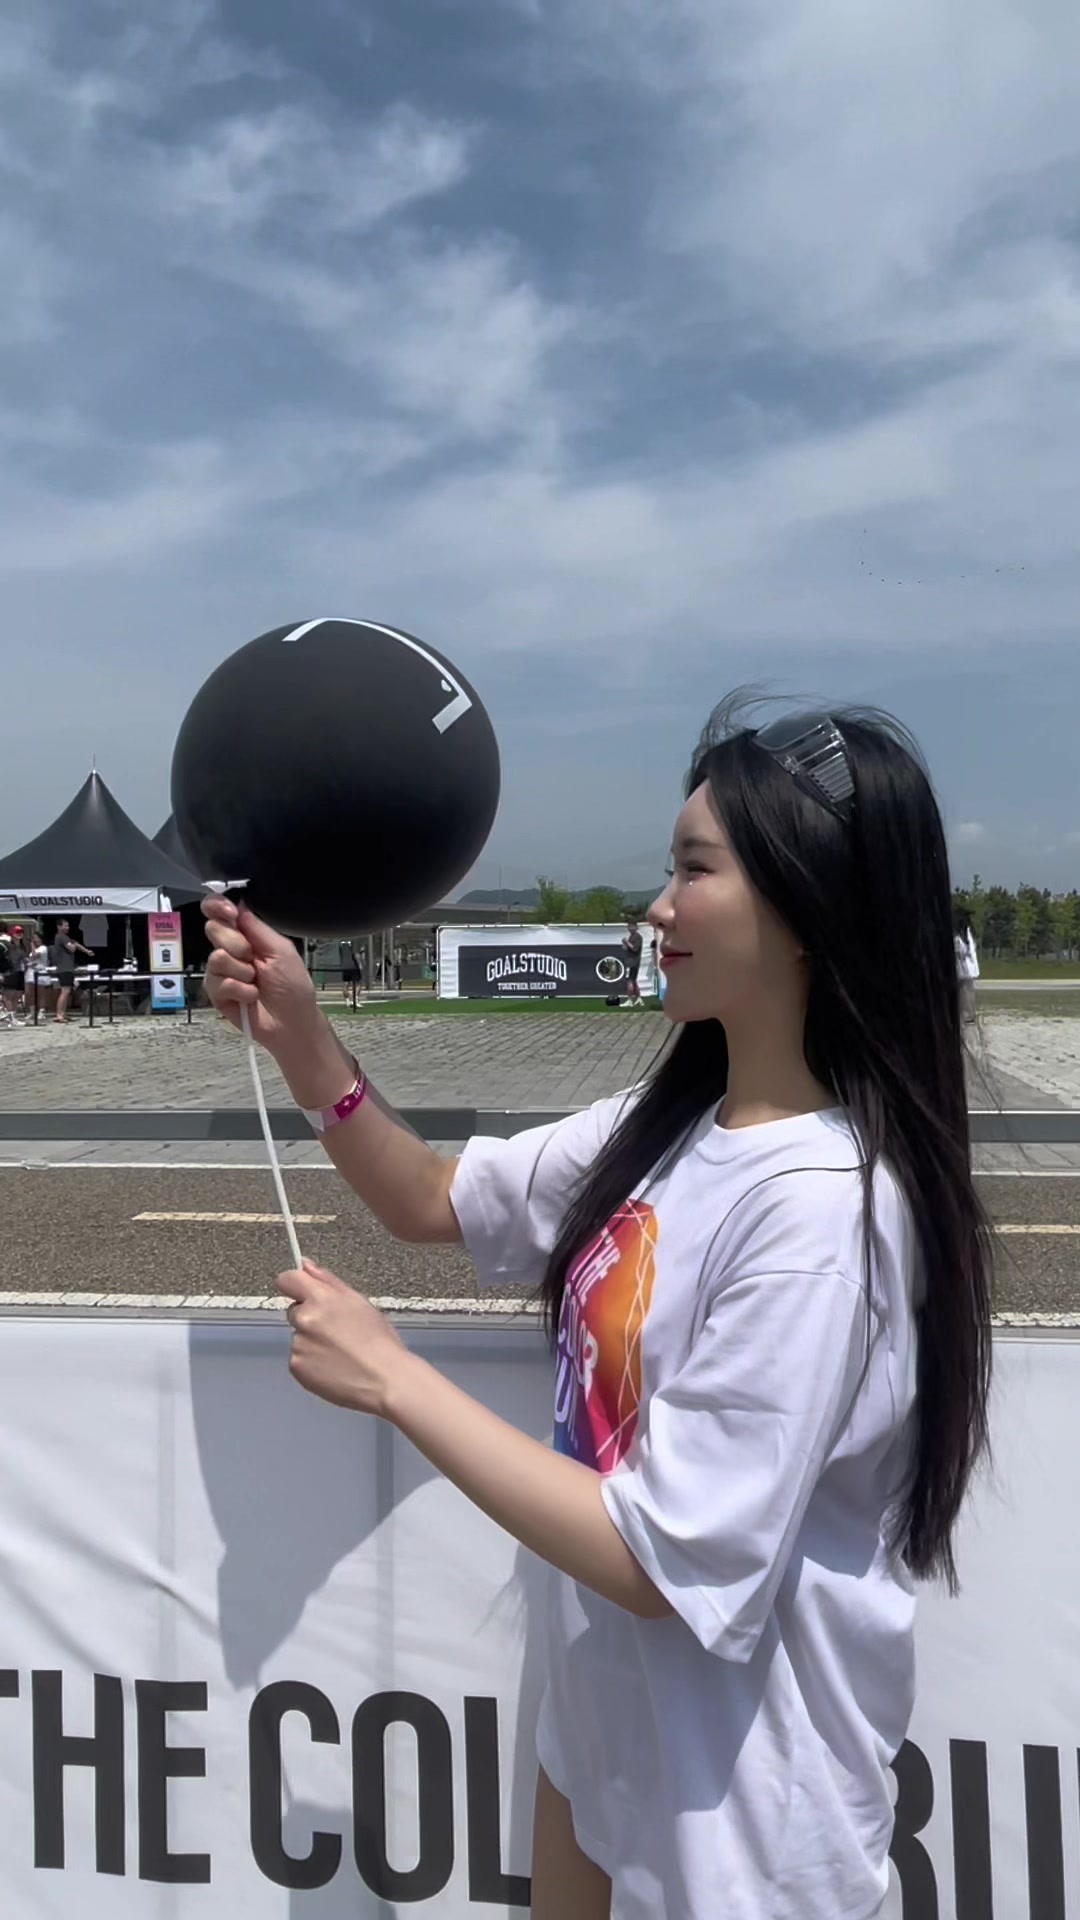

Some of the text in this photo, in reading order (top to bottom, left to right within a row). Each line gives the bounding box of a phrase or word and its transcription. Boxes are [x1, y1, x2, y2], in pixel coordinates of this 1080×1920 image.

[30, 896, 103, 906] GOALSTUDIO
[486, 952, 567, 982] GOALSTUDIO
[248, 1679, 532, 1908] COL
